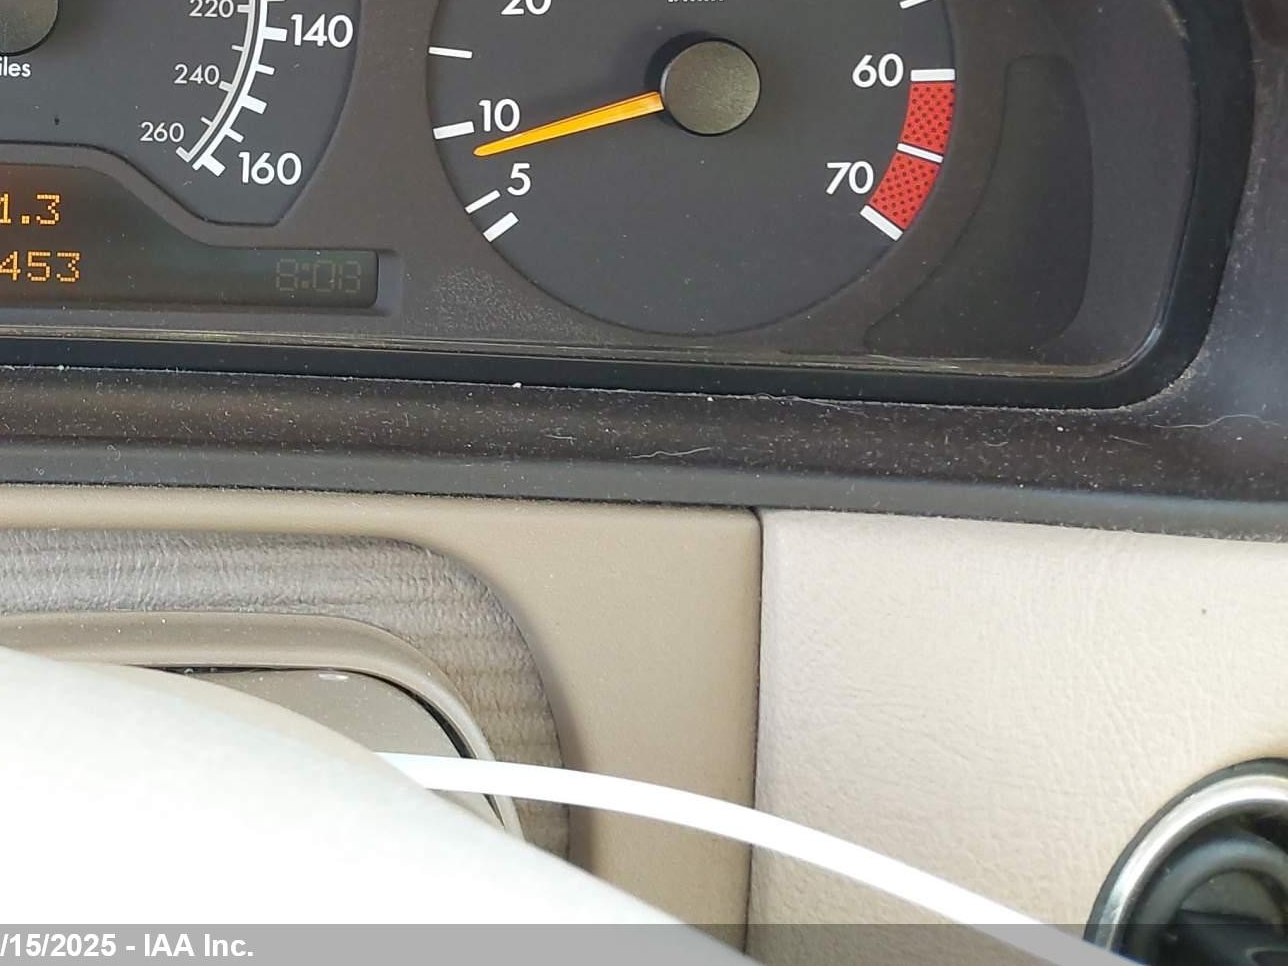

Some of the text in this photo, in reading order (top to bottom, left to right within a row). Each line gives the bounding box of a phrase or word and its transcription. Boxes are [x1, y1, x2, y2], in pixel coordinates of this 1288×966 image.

[290, 13, 354, 48] 140
[174, 63, 216, 85] 240
[852, 53, 904, 88] 60
[140, 121, 184, 143] 260
[478, 98, 520, 132] 10
[238, 151, 302, 186] 160
[507, 162, 531, 196] 5
[826, 161, 874, 194] 70
